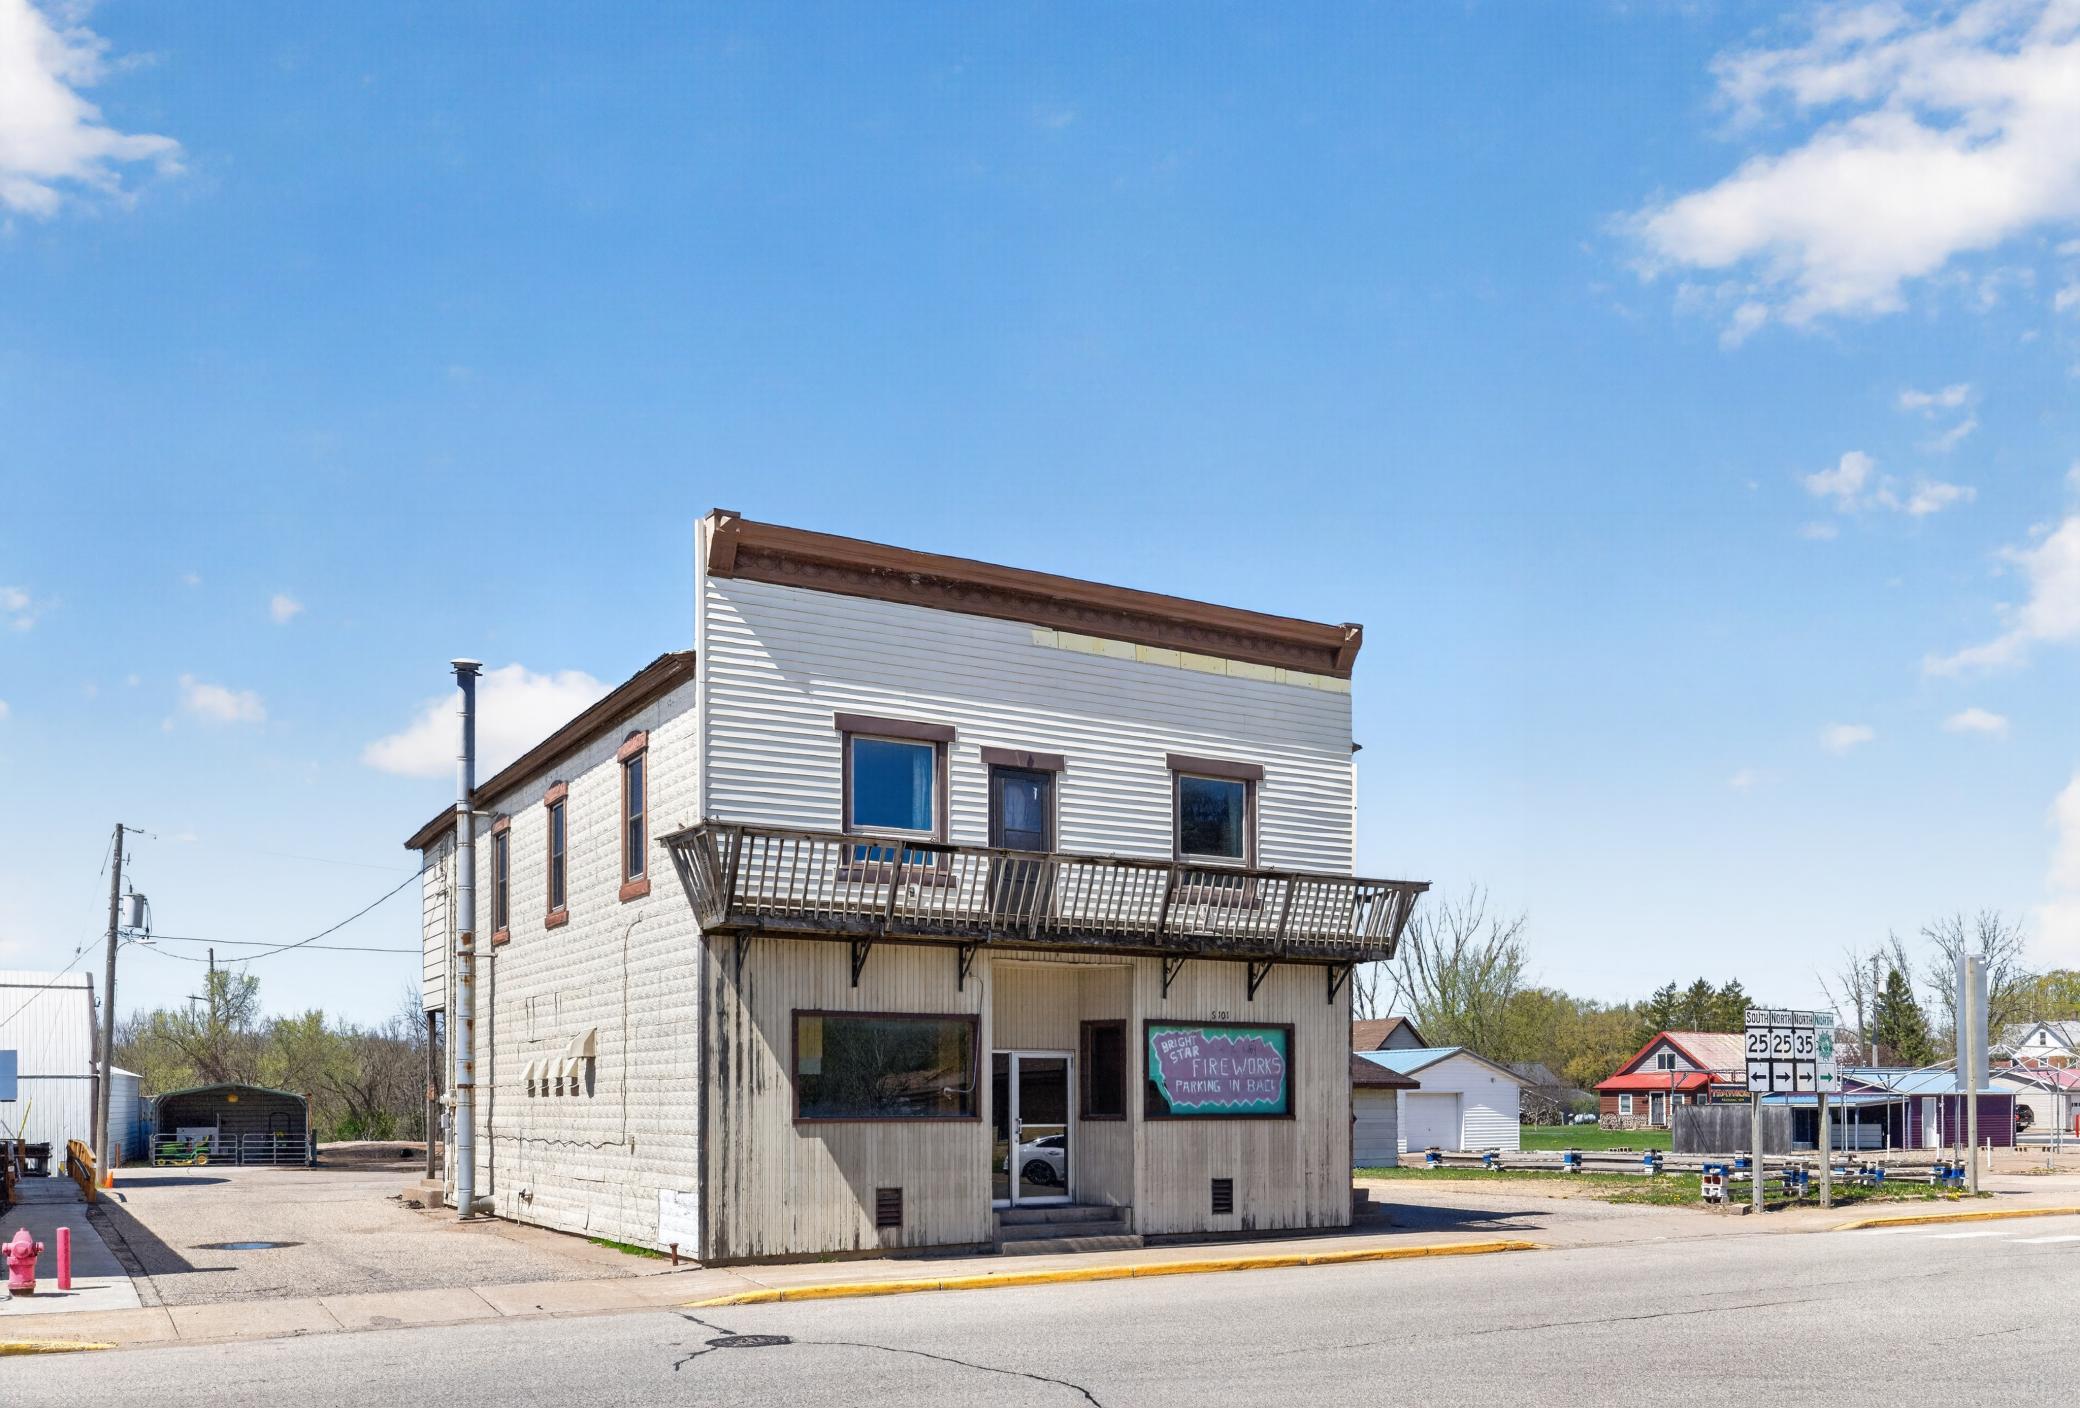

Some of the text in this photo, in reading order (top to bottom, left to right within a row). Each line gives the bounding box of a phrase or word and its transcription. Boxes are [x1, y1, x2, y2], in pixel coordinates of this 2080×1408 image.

[1746, 1011, 1769, 1024] SOUTH
[1771, 1013, 1792, 1025] NORTH
[1794, 1014, 1813, 1026] NORTH
[1161, 1035, 1198, 1054] BRIGHT
[1748, 1034, 1769, 1054] 25
[1773, 1034, 1792, 1054] 25
[1796, 1035, 1814, 1054] 35
[1170, 1046, 1200, 1065] STAR
[1175, 1079, 1221, 1093] PARKING
[1229, 1079, 1240, 1093] IN
